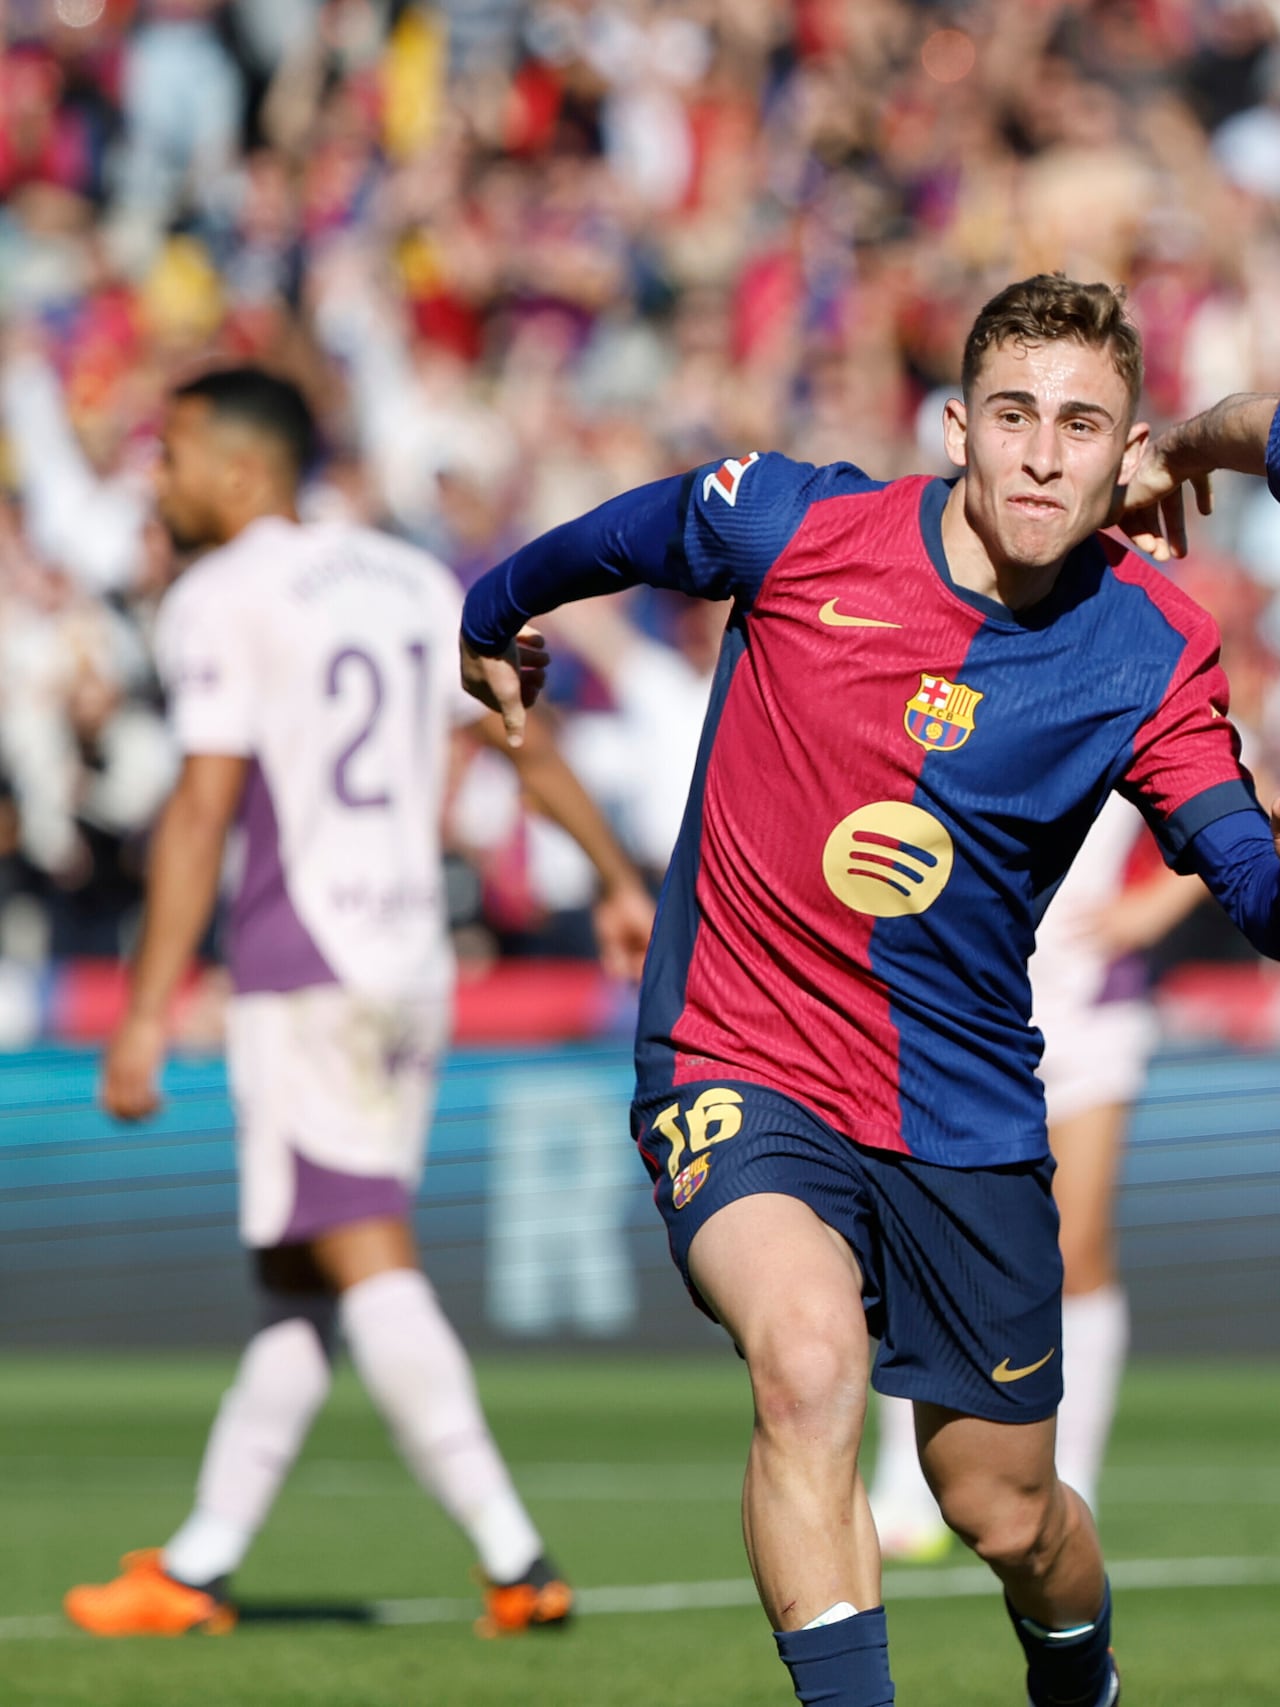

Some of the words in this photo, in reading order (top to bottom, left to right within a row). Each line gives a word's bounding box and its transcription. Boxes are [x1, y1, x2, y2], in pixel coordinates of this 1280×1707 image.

[326, 644, 430, 808] 21
[927, 705, 954, 722] FCB
[651, 1087, 744, 1180] 16
